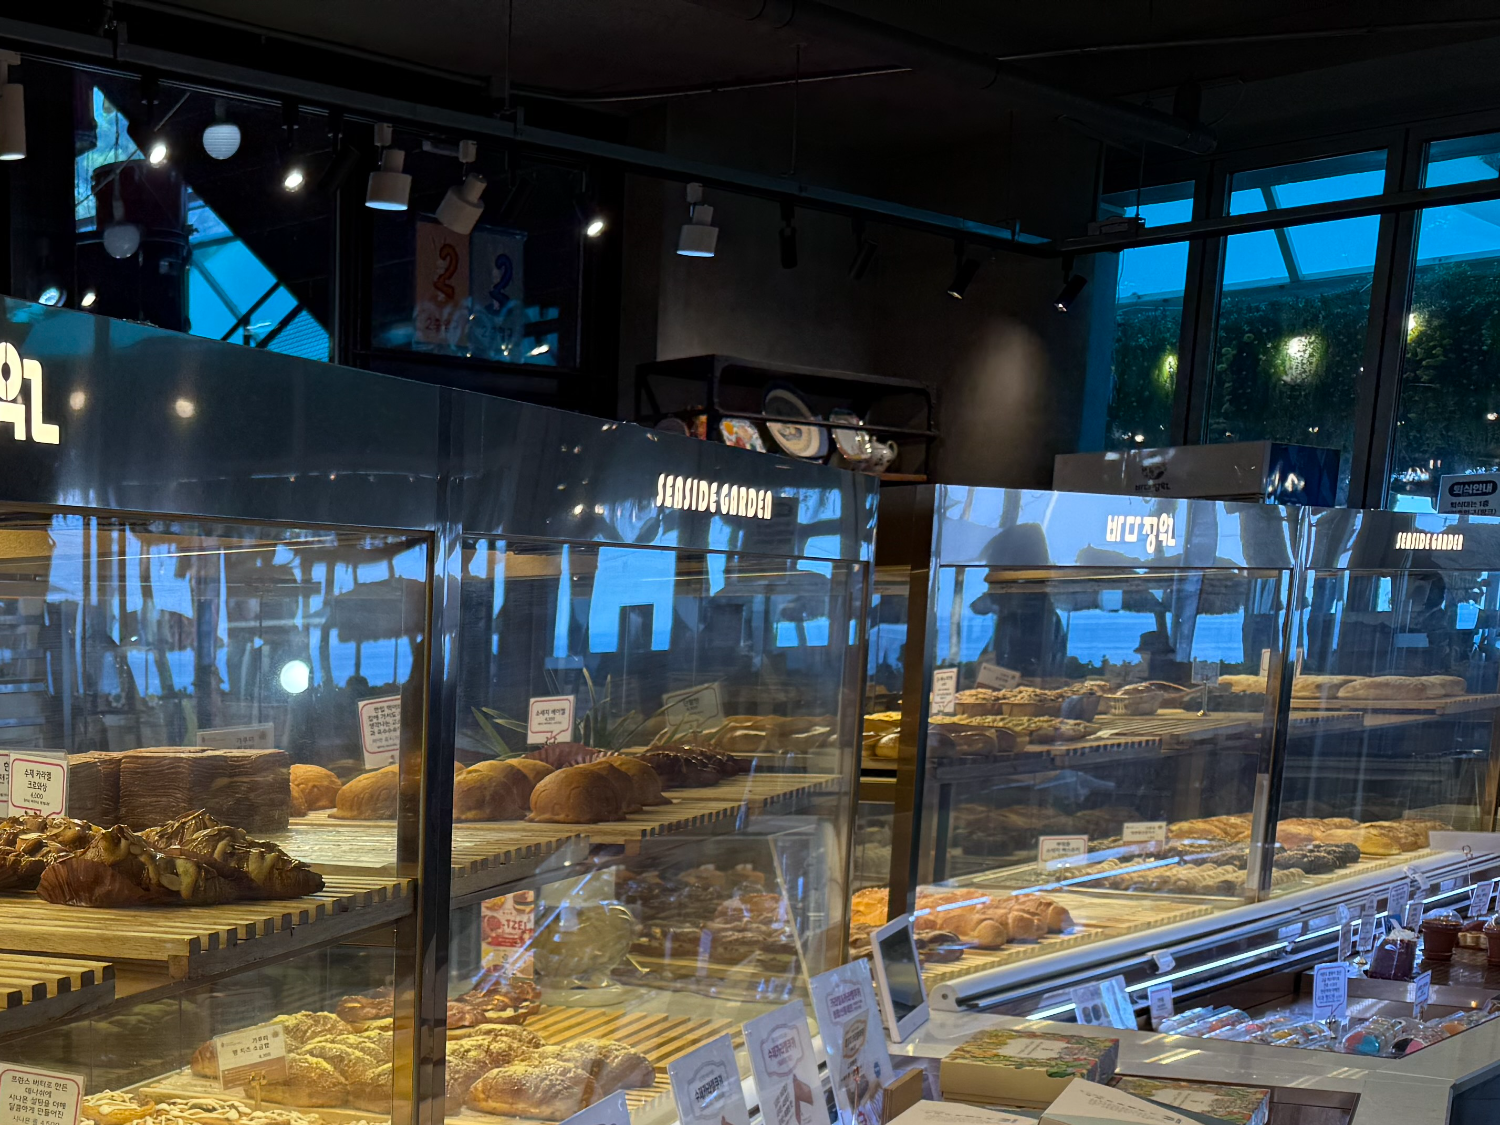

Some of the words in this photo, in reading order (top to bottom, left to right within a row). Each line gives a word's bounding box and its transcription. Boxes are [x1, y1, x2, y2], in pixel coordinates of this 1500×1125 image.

[656, 473, 718, 513] SEASIDE
[720, 483, 773, 520] GARDEN
[1453, 482, 1493, 495] 퇴식안내
[1106, 513, 1176, 554] 바다정원
[1396, 532, 1431, 550] SEASIDE
[1432, 533, 1463, 550] GARDEN
[11, 1075, 30, 1085] 프랑스
[32, 1078, 53, 1089] 버터로
[54, 1082, 68, 1092] 만든
[8, 1094, 28, 1104] 시나몬
